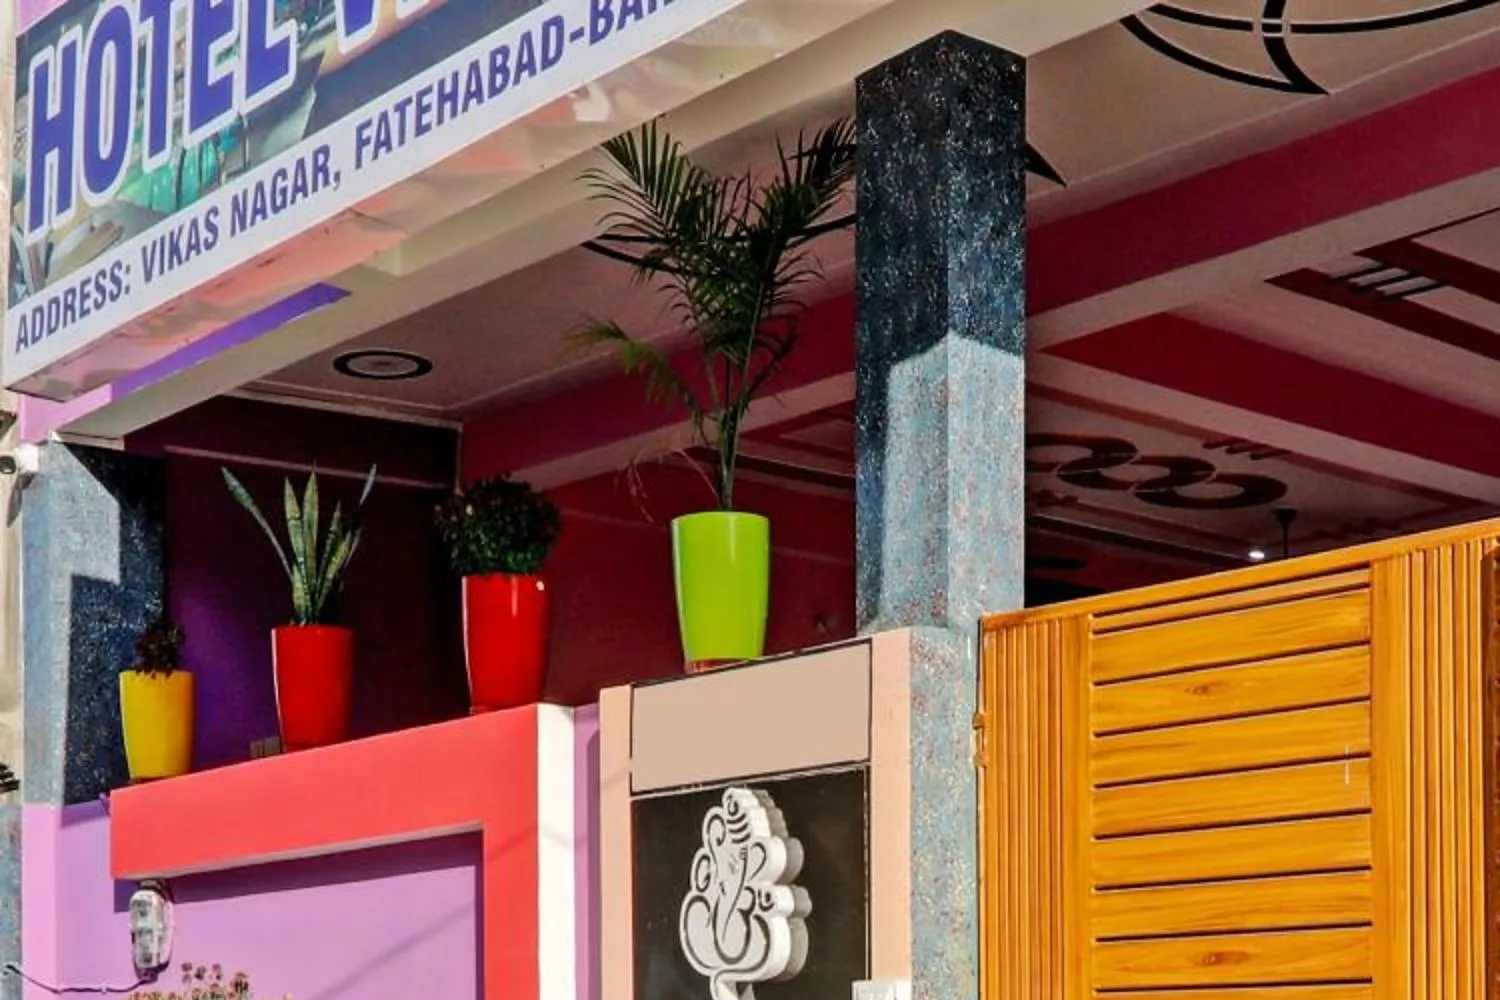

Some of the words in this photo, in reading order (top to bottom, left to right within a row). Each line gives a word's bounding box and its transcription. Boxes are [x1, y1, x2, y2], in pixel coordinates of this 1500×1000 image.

[15, 258, 131, 353] ADDRESS:
[141, 205, 220, 284] VIKAS
[230, 144, 341, 238] NAGAR,
[355, 0, 675, 169] FATEHABAD-BA
[27, 0, 295, 240] HOTEL
